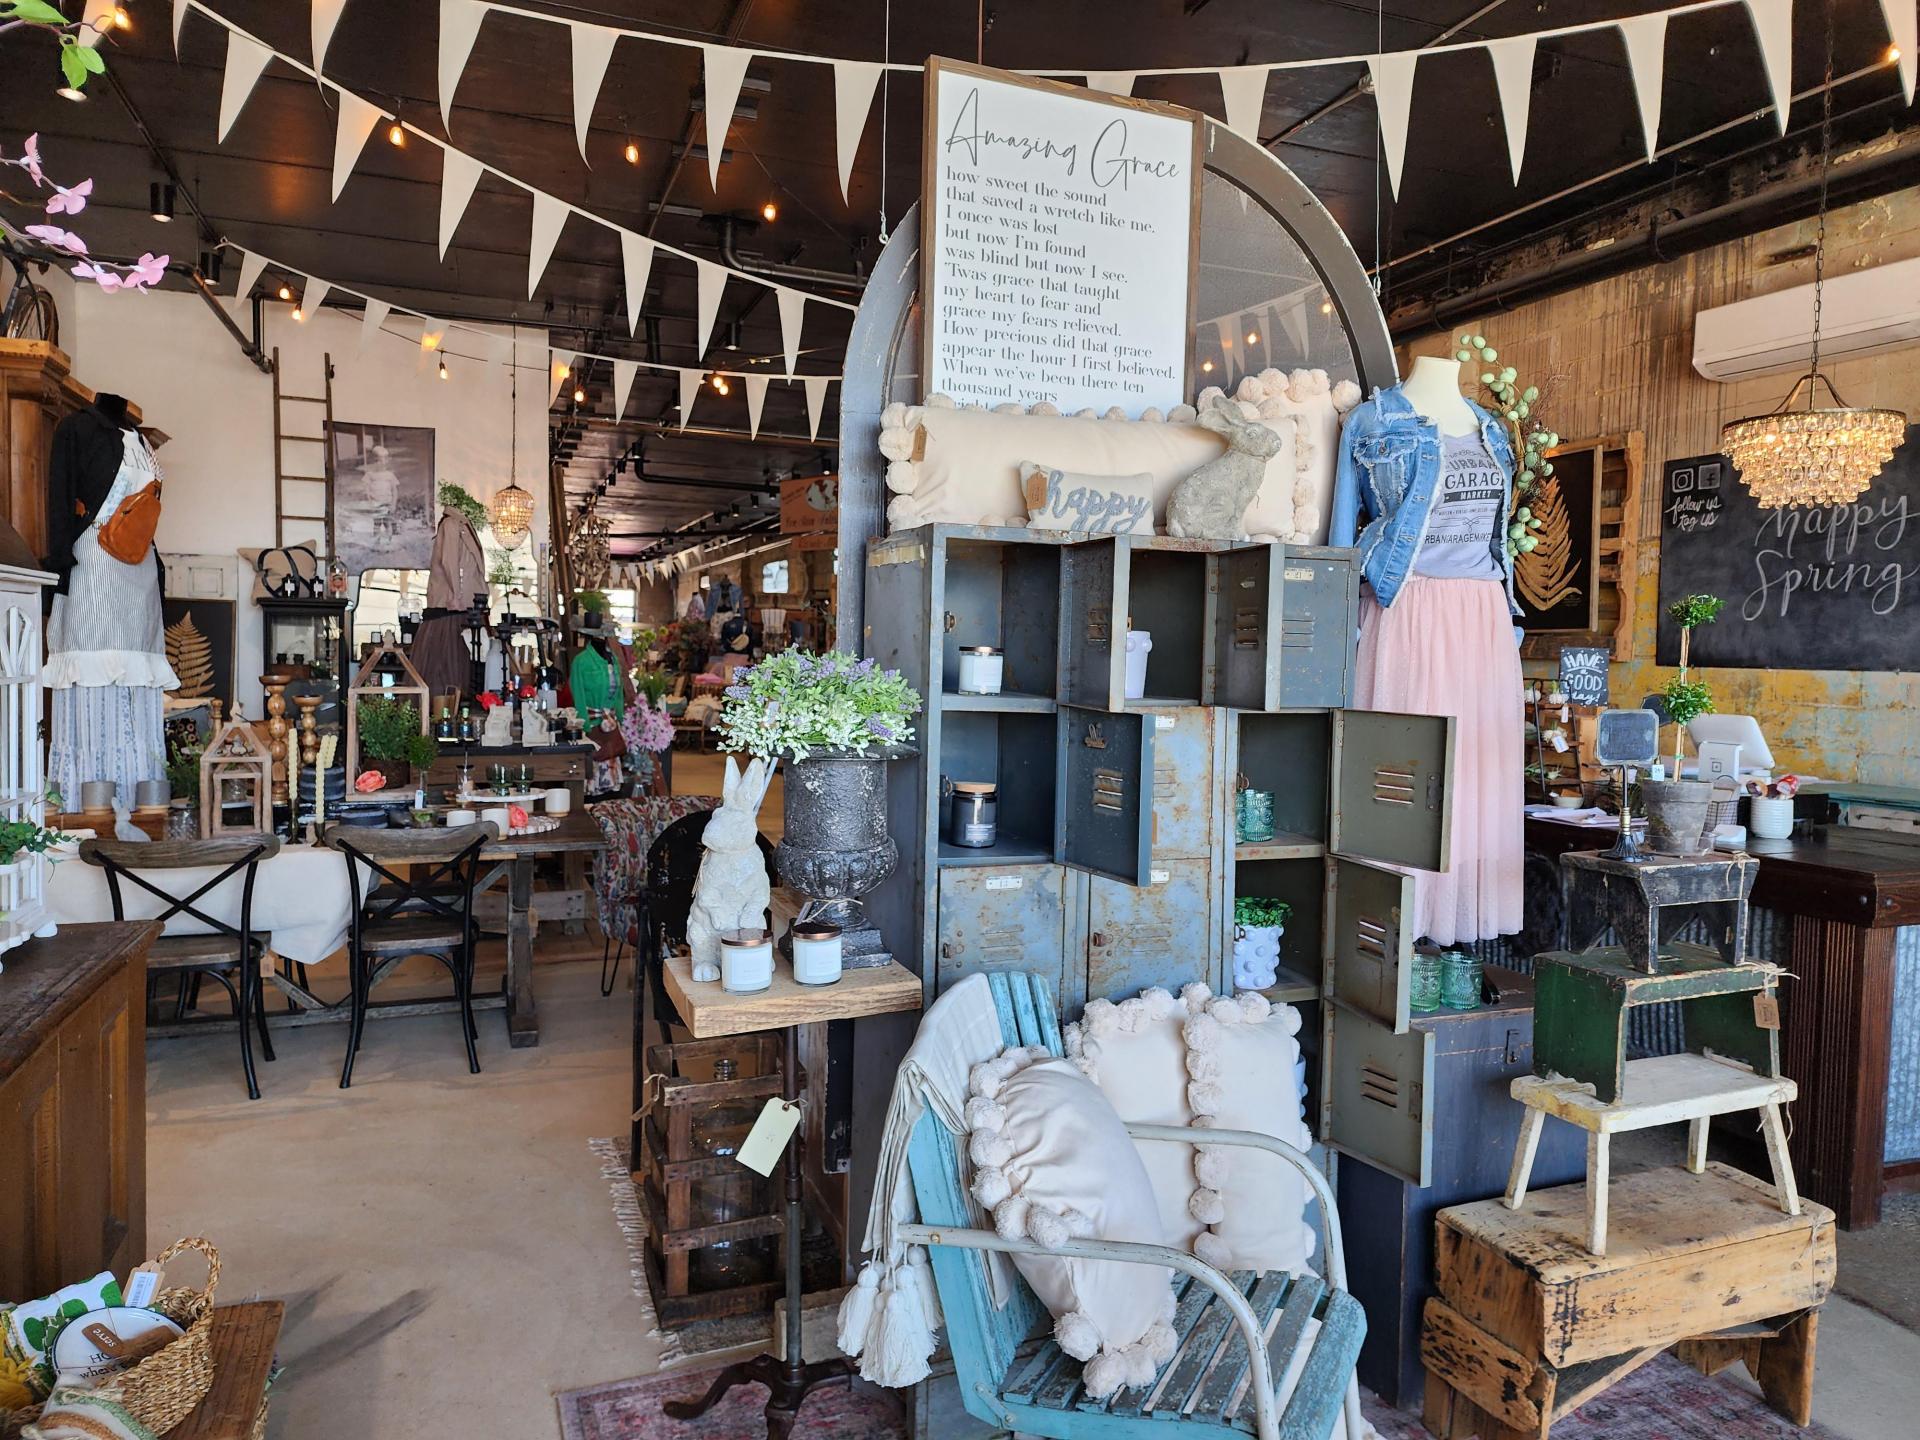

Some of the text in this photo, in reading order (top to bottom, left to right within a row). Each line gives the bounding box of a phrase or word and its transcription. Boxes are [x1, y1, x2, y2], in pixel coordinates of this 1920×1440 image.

[945, 86, 1180, 192] Amazing Grace
[946, 164, 1107, 207] how sweet the sound
[945, 184, 1155, 234] that saved a wretch like me.
[957, 209, 993, 224] once
[998, 216, 1028, 231] was
[1032, 217, 1057, 236] lost
[944, 222, 969, 241] but
[976, 231, 1009, 246] now
[1044, 238, 1086, 259] found
[944, 246, 975, 262] was
[980, 246, 1019, 268] blind
[1024, 253, 1048, 272] but
[1054, 262, 1086, 276] now
[1100, 270, 1128, 284] see.
[943, 284, 1101, 316] my heart to fear and
[991, 272, 1035, 288] grace
[1039, 275, 1067, 293] that
[1073, 281, 1119, 302] taught
[942, 304, 1121, 337] grace my fears relieved.
[942, 318, 1152, 358] How precious did that grace
[941, 344, 996, 362] appear
[1000, 345, 1025, 361] the
[1030, 348, 1067, 367] hour
[1082, 354, 1111, 372] first
[1116, 358, 1176, 380] believed.
[942, 356, 987, 377] When
[1040, 367, 1075, 386] been
[1080, 373, 1118, 390] there
[1122, 378, 1144, 394] ten
[941, 376, 1058, 402] thousand years
[1444, 471, 1504, 490] GARAG
[1449, 458, 1498, 472] URBAN
[1040, 469, 1151, 535] happy
[1460, 490, 1492, 501] MARKET
[1664, 494, 1722, 525] follow us
[1676, 511, 1720, 532] tag us
[1742, 549, 1920, 621] Spring
[1563, 652, 1604, 670] HAVE
[1563, 673, 1603, 691] GOOD
[92, 1328, 117, 1348] serve
